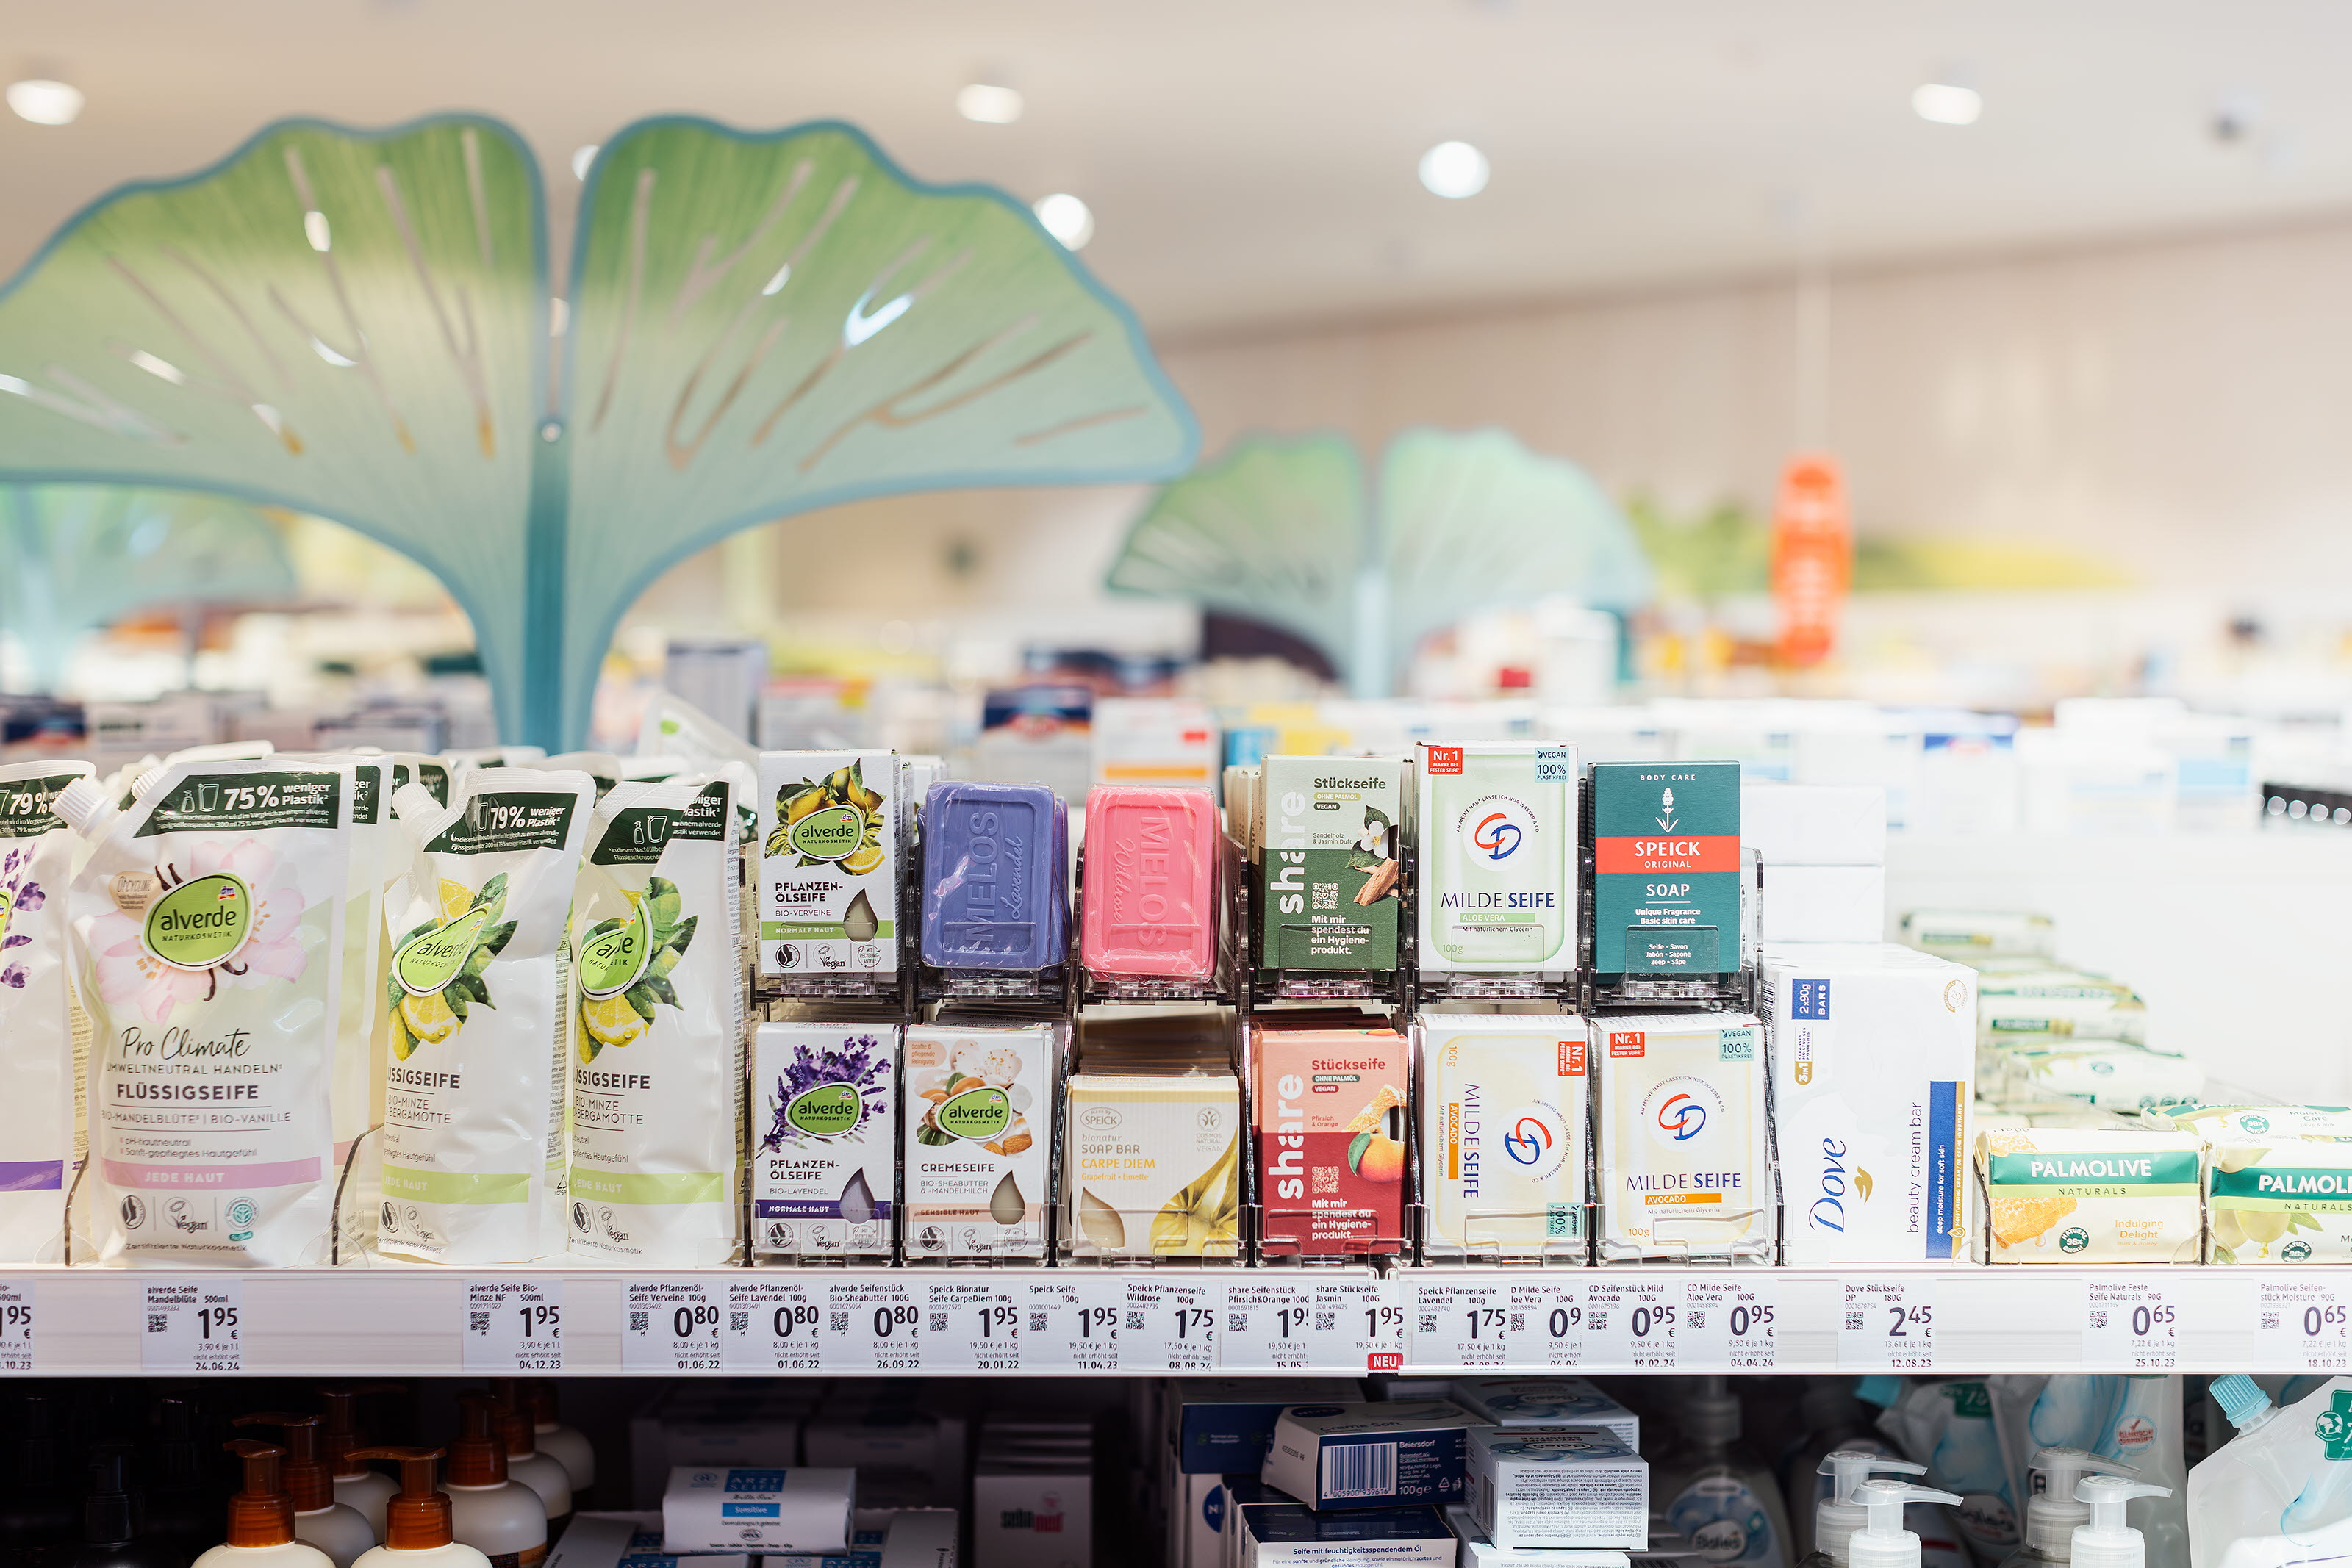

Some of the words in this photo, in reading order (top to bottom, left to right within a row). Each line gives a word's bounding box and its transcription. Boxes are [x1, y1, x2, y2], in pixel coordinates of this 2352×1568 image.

[1537, 764, 1566, 774] 100%
[1313, 777, 1386, 790] Stückseife
[283, 783, 331, 796] weniger
[224, 784, 279, 810] 75%
[1334, 792, 1358, 800] PALMÖL
[531, 805, 566, 820] weniger
[490, 806, 526, 830] 79%
[801, 825, 854, 838] alverde
[1270, 791, 1305, 915] share
[1635, 841, 1701, 857] SPEICK
[964, 811, 999, 942] MELOS
[1000, 834, 1024, 920] Lavendel
[1137, 816, 1170, 946] MELOS
[775, 882, 843, 891] PFLANZEN-
[1646, 883, 1690, 896] SOAP
[775, 891, 826, 903] ÖLSEIFE
[160, 905, 237, 930] alverde
[775, 909, 831, 917] BIO-VERVEINE
[1462, 913, 1482, 921] ALOE
[1484, 913, 1505, 921] VERA
[1635, 908, 1662, 917] Unique
[1663, 908, 1701, 917] Fragrance
[1311, 915, 1327, 924] Mit
[1329, 915, 1346, 924] mir
[1311, 926, 1355, 935] spendest
[1357, 926, 1369, 935] du
[162, 931, 232, 942] NATURKOSMETIK
[1311, 935, 1326, 944] ein
[1327, 935, 1369, 946] Hygiene-
[1311, 946, 1352, 955] produkt.
[1818, 984, 1826, 1015] BARS
[122, 1026, 155, 1059] Pro
[162, 1026, 252, 1060] Climate
[1311, 1058, 1385, 1071] Stückseife
[118, 1082, 259, 1100] FLÜSSIGSEIFE
[576, 1095, 619, 1111] BIO-MINZE
[948, 1105, 1003, 1118] alverde
[1909, 1101, 1922, 1126] bar
[212, 1112, 292, 1125] BIO-VANILLE
[1085, 1115, 1117, 1125] SPEICK
[1449, 1104, 1458, 1144] AVOCADO
[1268, 1073, 1304, 1200] share
[1082, 1144, 1113, 1154] SOAP
[1117, 1144, 1140, 1154] BAR
[593, 1152, 628, 1164] Hautgefühl
[1910, 1131, 1921, 1179] cream
[921, 1163, 994, 1173] CREMESEIFE
[1081, 1159, 1120, 1168] CARPE
[1124, 1159, 1155, 1168] DIEM
[2031, 1159, 2153, 1178] PALMOLIVE
[146, 1171, 181, 1182] JEDE
[185, 1171, 226, 1182] HAUT
[1081, 1173, 1116, 1182] Grapefruit
[1809, 1137, 1846, 1233] Dove
[770, 1187, 828, 1195] BIO-LAVENDEL
[2058, 1187, 2126, 1195] NATURALS
[1647, 1195, 1687, 1204] AVOCADO
[1937, 1185, 1945, 1215] moisture
[1906, 1184, 1922, 1234] beauty
[2284, 1203, 2352, 1211] NATURALS
[1936, 1216, 1944, 1234] deep
[2115, 1219, 2164, 1230] Indulging
[2120, 1230, 2159, 1241] Delight
[599, 1241, 642, 1255] Naturkosmetik
[147, 1285, 176, 1294] alverde
[178, 1285, 198, 1294] Seife
[629, 1284, 658, 1292] alverde
[660, 1284, 703, 1292] Pflanzenöl-
[1127, 1284, 1152, 1292] Speick
[1155, 1284, 1206, 1295] Pflanzenseife
[1601, 1284, 1645, 1292] Seifenstück
[1647, 1284, 1663, 1292] Mild
[1846, 1284, 1864, 1292] Dove
[1866, 1284, 1905, 1292] Stückseife
[2089, 1283, 2126, 1292] Palmolive
[2128, 1284, 2148, 1292] Feste
[147, 1295, 196, 1303] Mandelblüte
[204, 1295, 229, 1303] 500ml
[470, 1293, 493, 1302] Minze
[629, 1294, 649, 1302] Seife
[651, 1294, 685, 1302] Verveine
[689, 1294, 706, 1303] 100g
[829, 1294, 887, 1303] Bio-Sheabutter
[891, 1294, 910, 1302] 100G
[950, 1295, 993, 1303] CarpeDiem
[1228, 1295, 1291, 1305] Pfirsich&Orange
[1687, 1293, 1704, 1301] Aloe
[1705, 1293, 1723, 1301] Vera
[2282, 1293, 2315, 1301] Moisture
[196, 1362, 240, 1371] 24.06.24
[519, 1360, 561, 1370] 04.12.23
[678, 1360, 720, 1370] 01.06.22
[877, 1360, 919, 1369] 26.09.22
[1078, 1361, 1118, 1370] 11.04.23
[1374, 1356, 1397, 1367] NEU
[1730, 1358, 1774, 1367] 04.04.24
[2308, 1359, 2347, 1368] 18.10.23
[1399, 1440, 1436, 1450] Beiersdorf
[735, 1506, 767, 1514] Sensitive
[1311, 1547, 1324, 1555] mit
[1324, 1545, 1413, 1556] feuchtigkeitsspendendem
[1414, 1544, 1422, 1553] Öl
